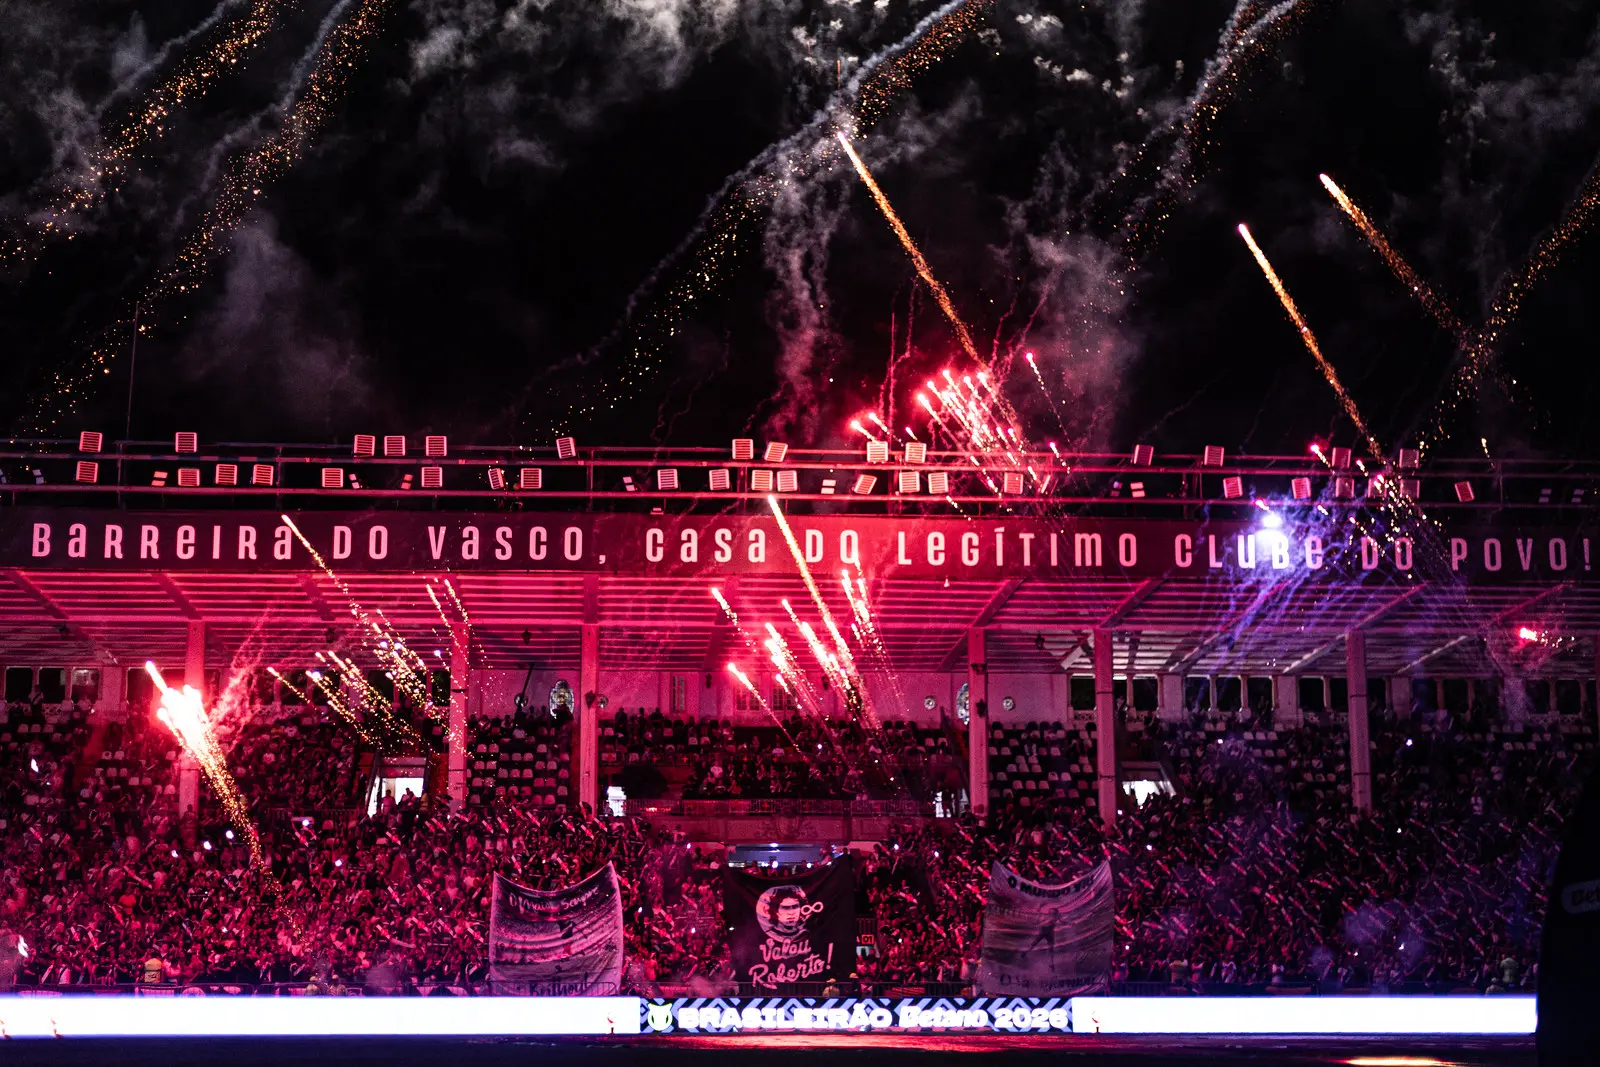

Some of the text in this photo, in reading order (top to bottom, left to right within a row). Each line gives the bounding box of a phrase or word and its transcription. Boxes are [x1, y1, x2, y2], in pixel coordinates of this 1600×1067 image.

[333, 525, 389, 560] DO
[805, 527, 860, 563] DO
[1361, 536, 1413, 571] DO
[1452, 537, 1592, 572] POVO!
[748, 942, 834, 990] Roberto!
[759, 938, 812, 962] Valeu
[677, 1003, 1069, 1029] BRASILEIRÃO Betano 2026
